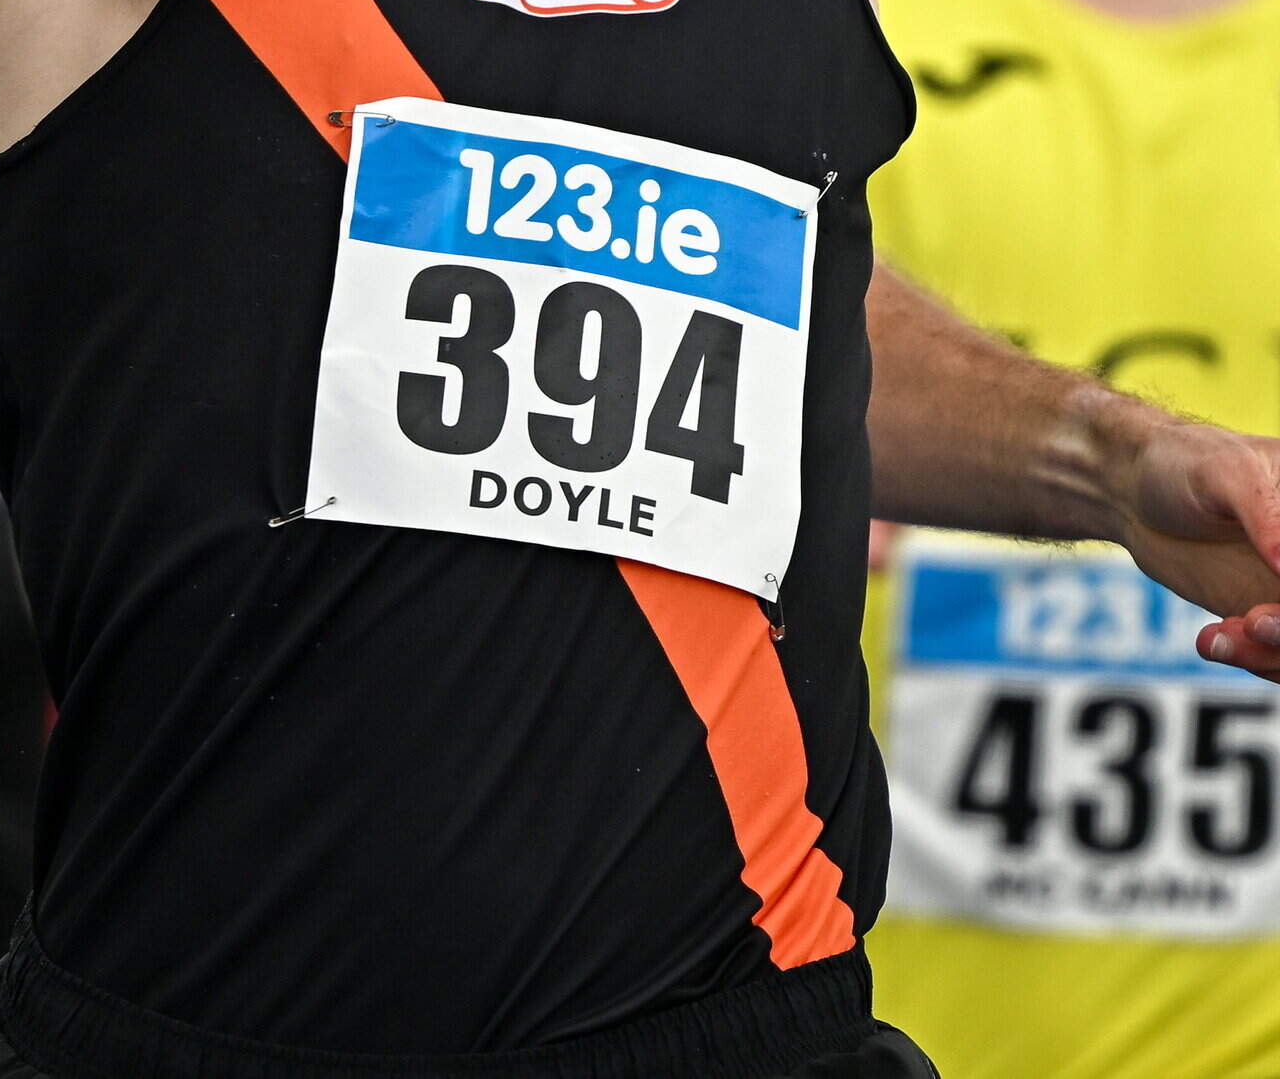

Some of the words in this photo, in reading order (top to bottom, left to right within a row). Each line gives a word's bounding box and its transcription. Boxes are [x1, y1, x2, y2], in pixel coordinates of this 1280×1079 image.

[460, 149, 721, 275] 123.ie
[396, 264, 745, 505] 394
[469, 469, 657, 538] DOYLE
[951, 690, 1280, 863] 435
